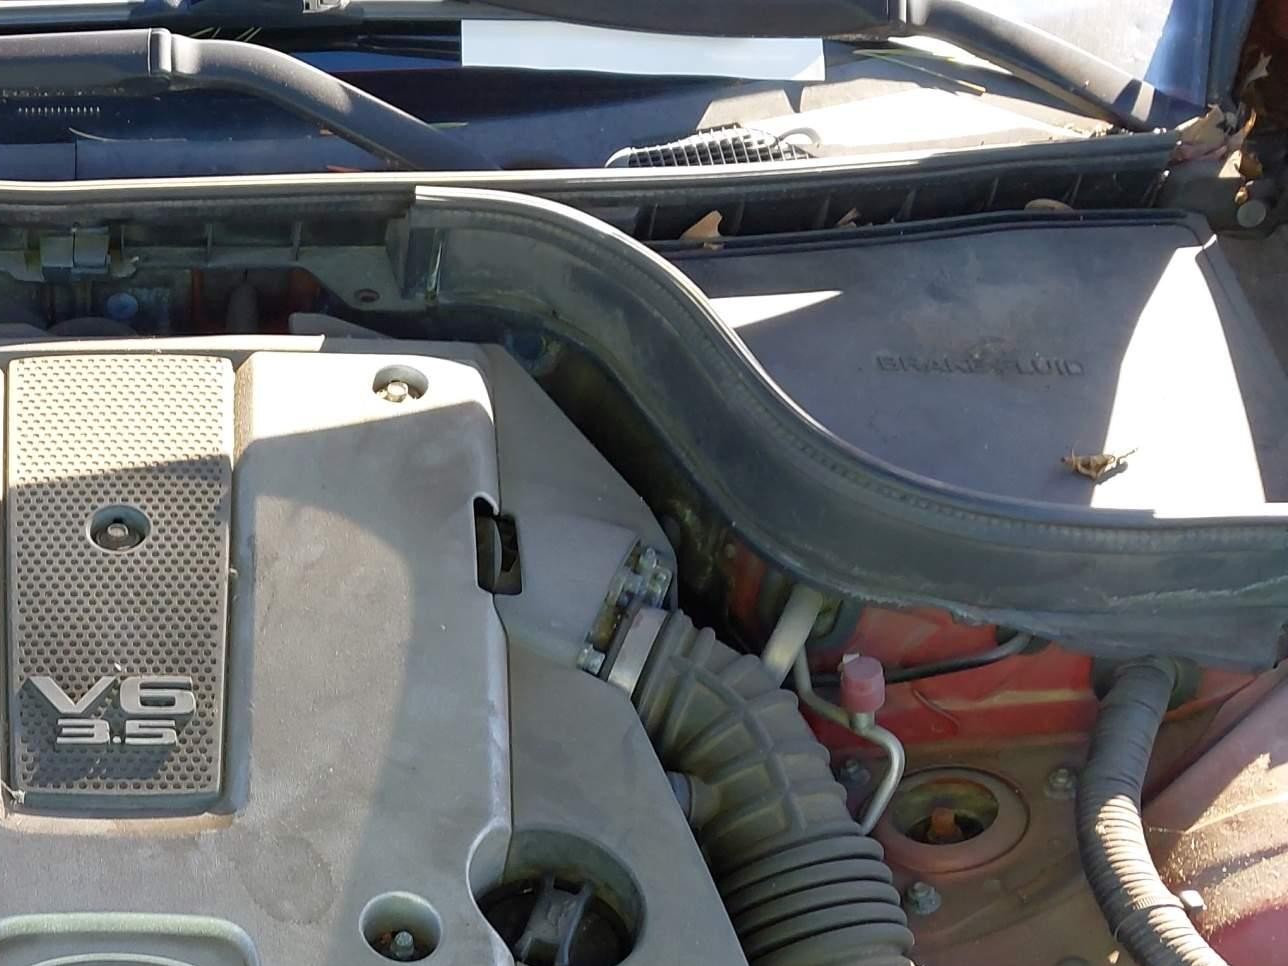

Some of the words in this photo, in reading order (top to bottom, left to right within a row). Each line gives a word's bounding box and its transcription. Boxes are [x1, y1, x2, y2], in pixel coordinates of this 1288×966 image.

[875, 355, 986, 374] BRAKE
[28, 675, 197, 715] V6
[56, 718, 178, 745] 3.5
